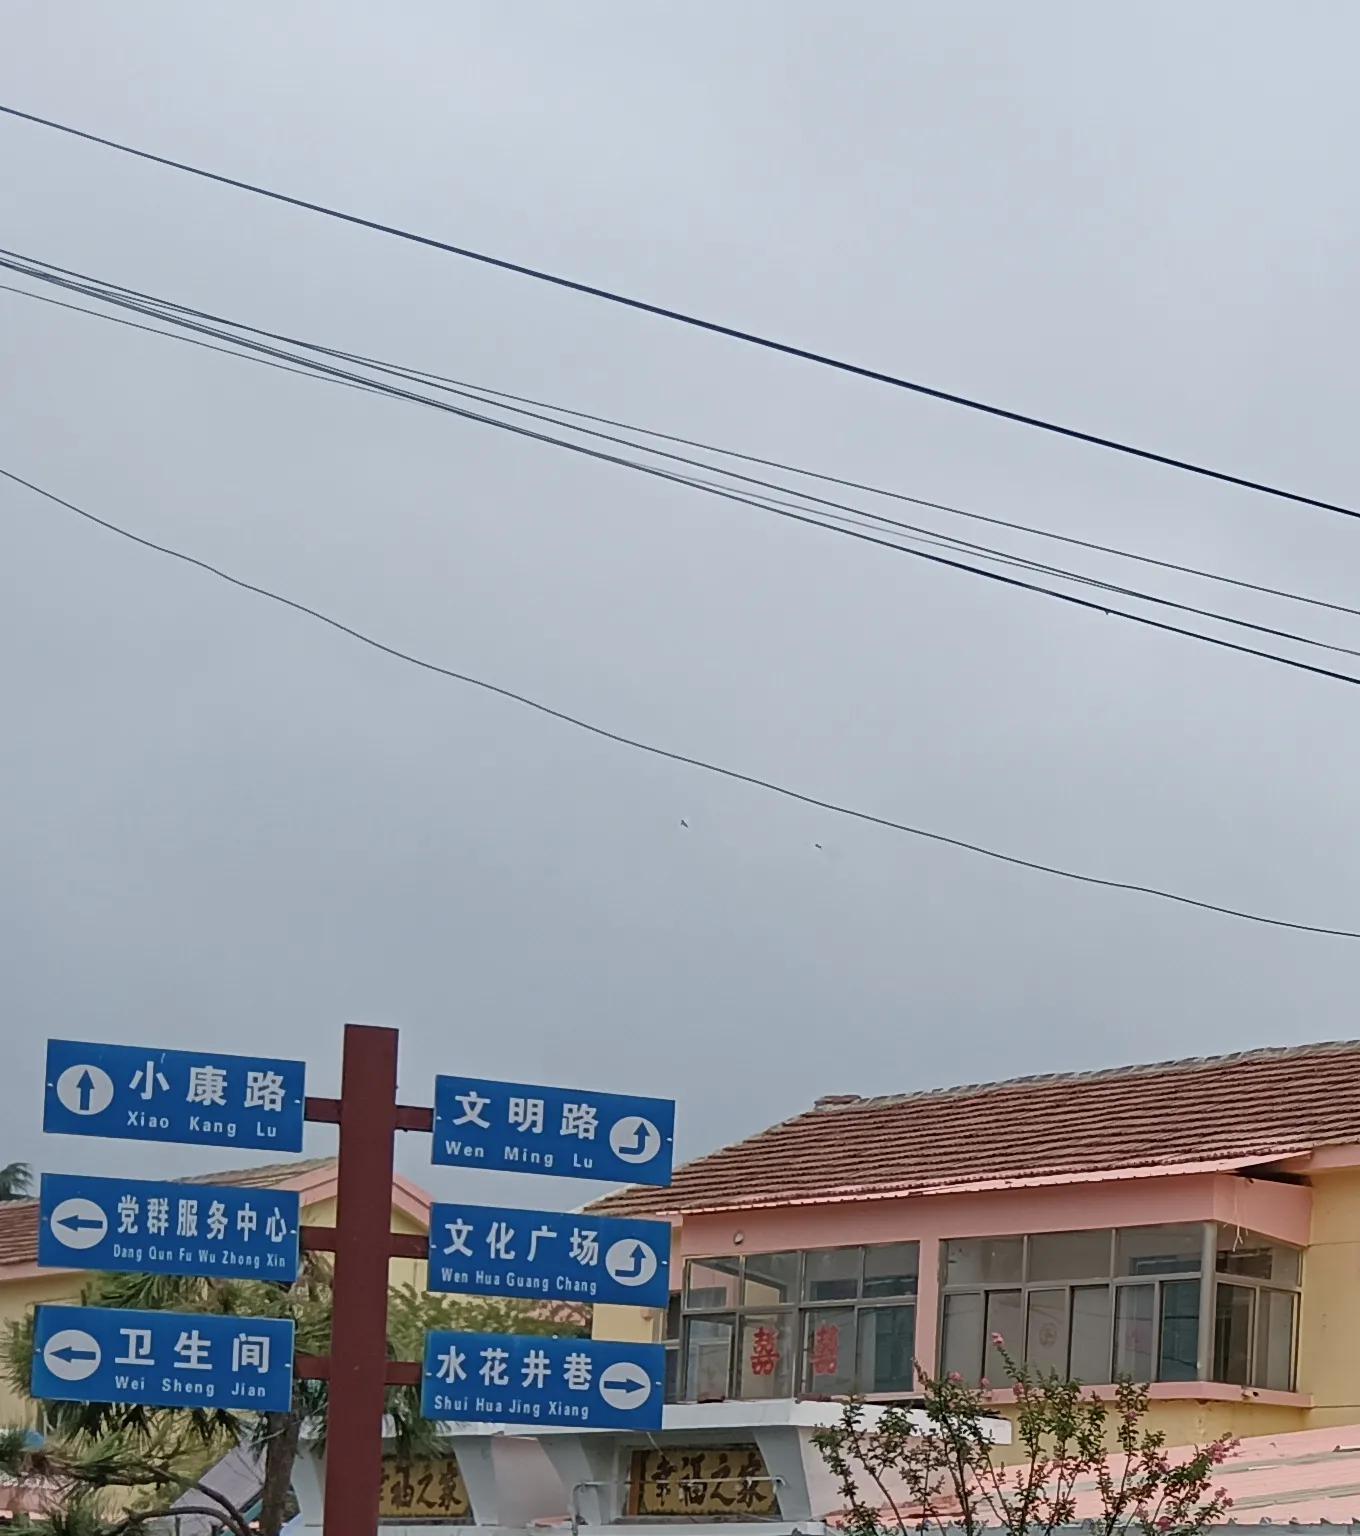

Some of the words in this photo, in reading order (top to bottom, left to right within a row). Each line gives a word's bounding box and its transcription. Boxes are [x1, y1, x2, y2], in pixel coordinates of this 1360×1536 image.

[129, 1060, 286, 1112] 小康路
[127, 1111, 169, 1129] Xiao
[189, 1116, 236, 1138] Kang
[256, 1121, 277, 1137] Lu
[452, 1091, 599, 1140] 文明路
[445, 1140, 484, 1158] Wen
[504, 1146, 553, 1168] Ming
[573, 1153, 593, 1168] Lu
[117, 1194, 287, 1243] 党群服务中心
[113, 1244, 142, 1262] Dang
[149, 1246, 172, 1260] Qun
[179, 1247, 192, 1261] Fu
[198, 1250, 216, 1263] Wu
[222, 1250, 260, 1269] Zhong
[267, 1253, 285, 1267] Xin
[443, 1218, 599, 1266] 文化广场
[441, 1268, 468, 1283] Wen
[475, 1270, 500, 1285] Hua
[506, 1272, 549, 1292] Guang
[556, 1275, 596, 1296] Chang
[114, 1328, 270, 1374] 卫生间
[436, 1345, 593, 1391] 水花井巷
[115, 1375, 145, 1390] Wei
[162, 1378, 214, 1397] Sheng
[231, 1382, 266, 1397] Jian
[434, 1395, 468, 1411] Shui
[475, 1398, 502, 1412] Hua
[509, 1400, 540, 1418] Jing
[548, 1401, 589, 1420] Xiang
